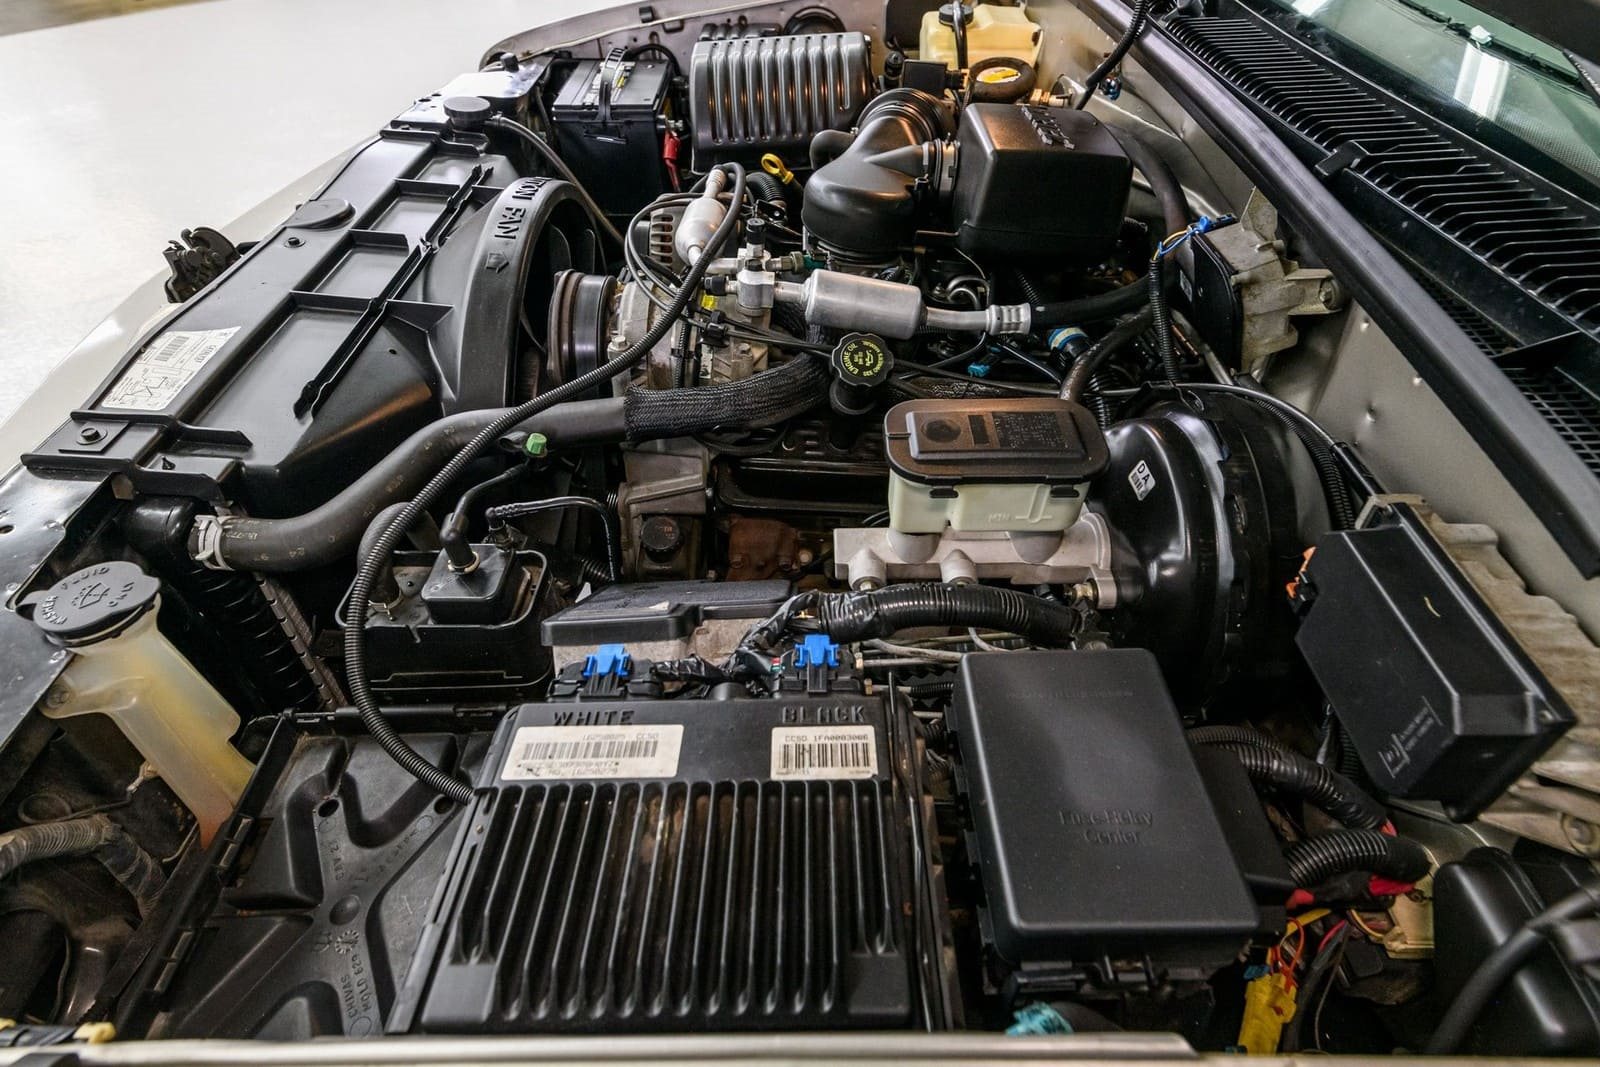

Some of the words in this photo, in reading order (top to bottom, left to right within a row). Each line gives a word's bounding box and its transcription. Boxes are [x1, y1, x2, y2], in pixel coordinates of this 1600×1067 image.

[494, 206, 526, 239] FAN
[848, 343, 858, 352] OIL
[844, 352, 859, 374] ENGINE
[61, 566, 110, 591] FLUID
[107, 581, 135, 607] ONLY
[41, 594, 68, 625] WASHER
[553, 710, 636, 726] WHITE
[781, 704, 865, 724] BLACK
[341, 975, 357, 1017] CHIVAS
